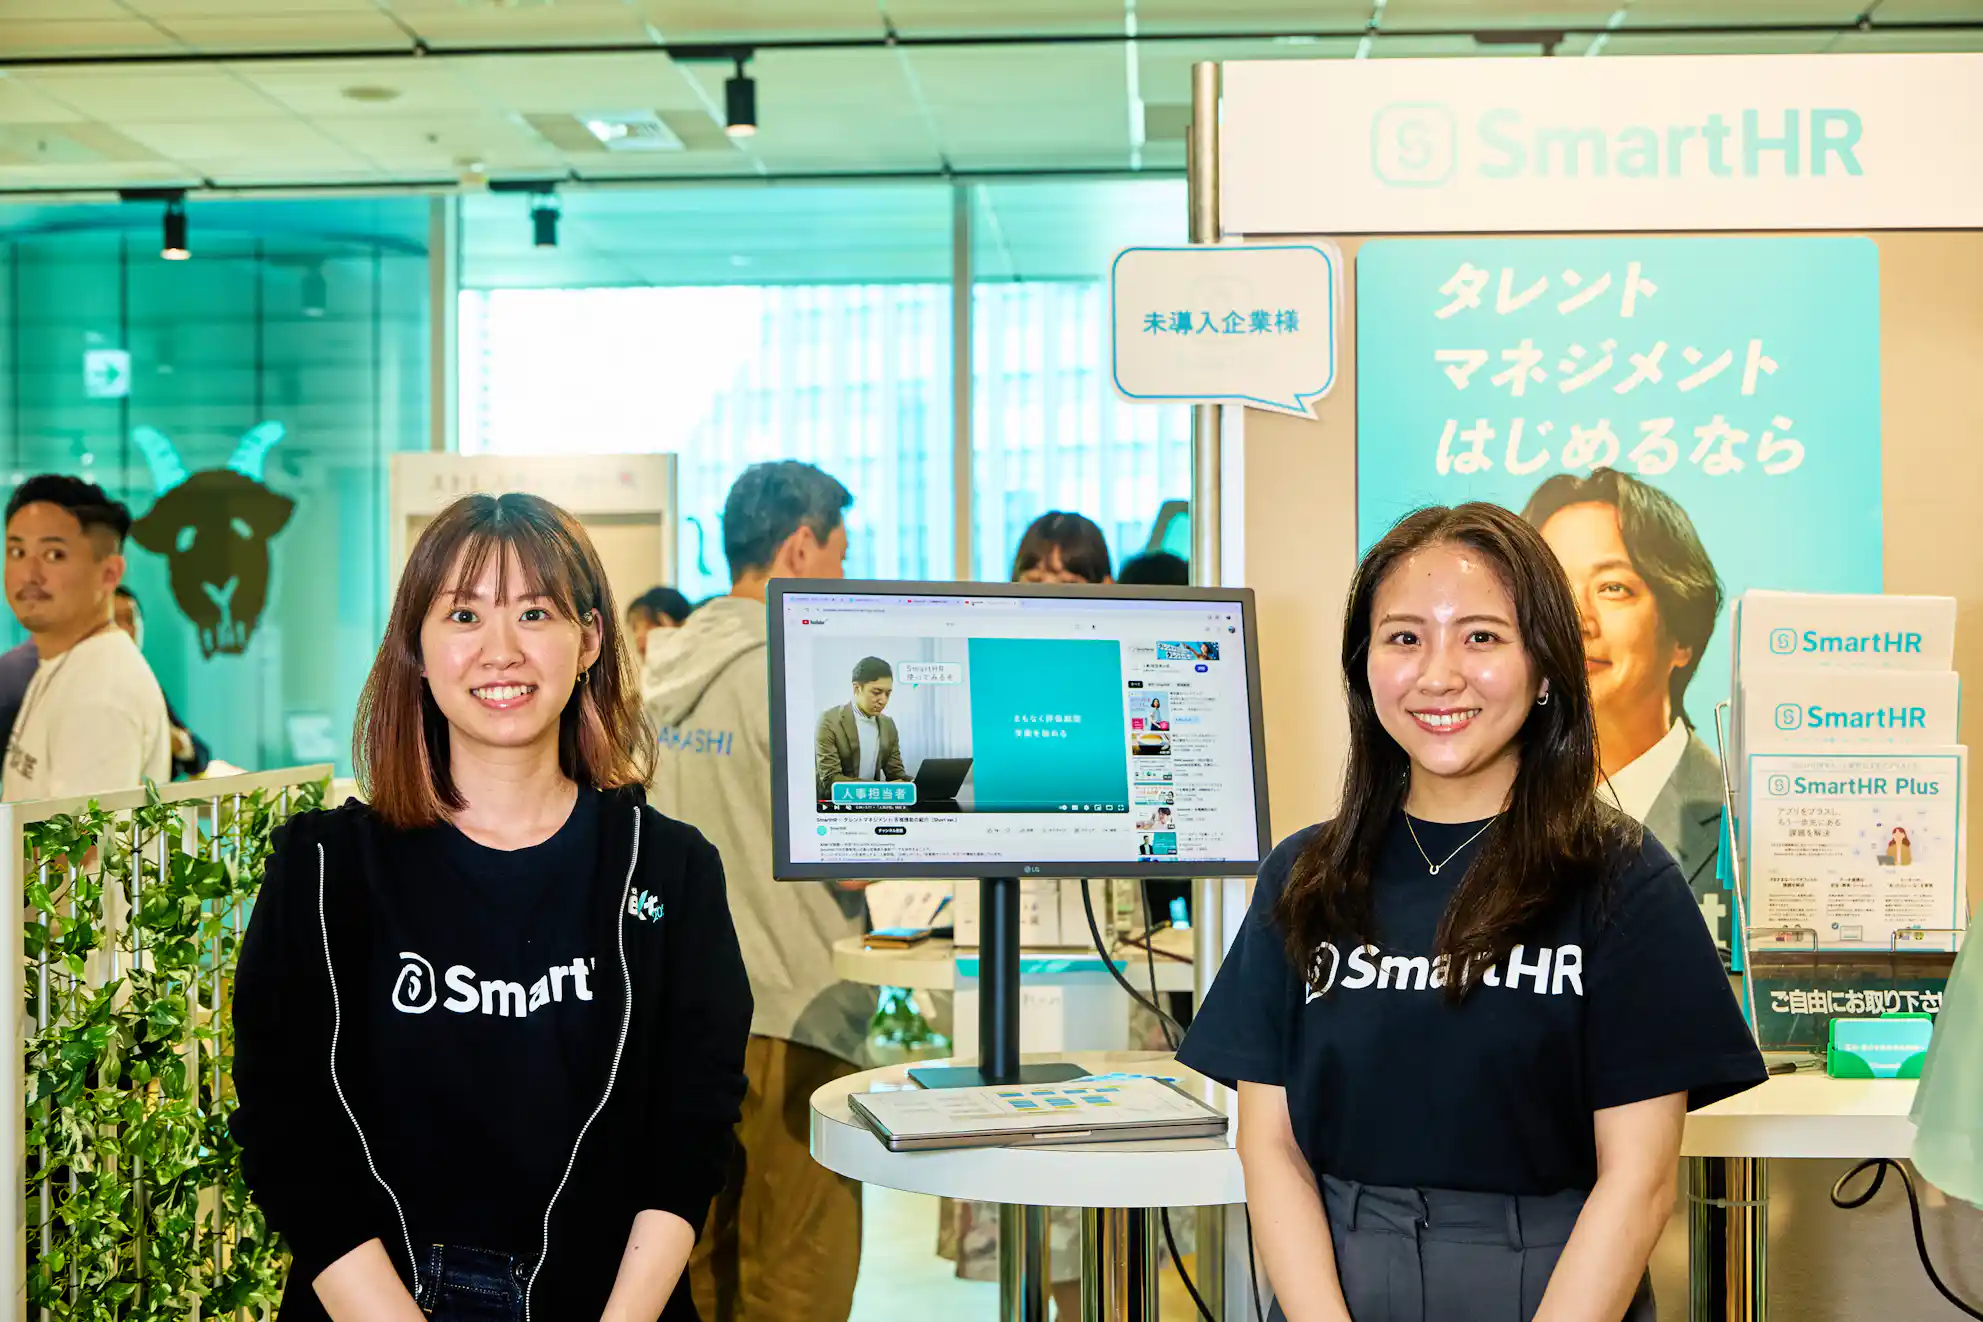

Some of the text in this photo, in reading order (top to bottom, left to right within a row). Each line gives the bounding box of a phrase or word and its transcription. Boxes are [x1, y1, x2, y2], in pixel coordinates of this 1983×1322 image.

[1476, 106, 1865, 180] SmartHR
[1434, 260, 1660, 320] タレント
[1142, 309, 1300, 335] 未導入企業様
[1432, 338, 1780, 397] マネジメント
[1434, 414, 1807, 477] はじめるなら
[1802, 630, 1923, 653] SmartHR
[1807, 705, 1926, 728] SmartHR
[841, 788, 907, 800] 人事担当者
[1794, 776, 1940, 795] SmartHR Plus
[443, 957, 595, 1017] Smart
